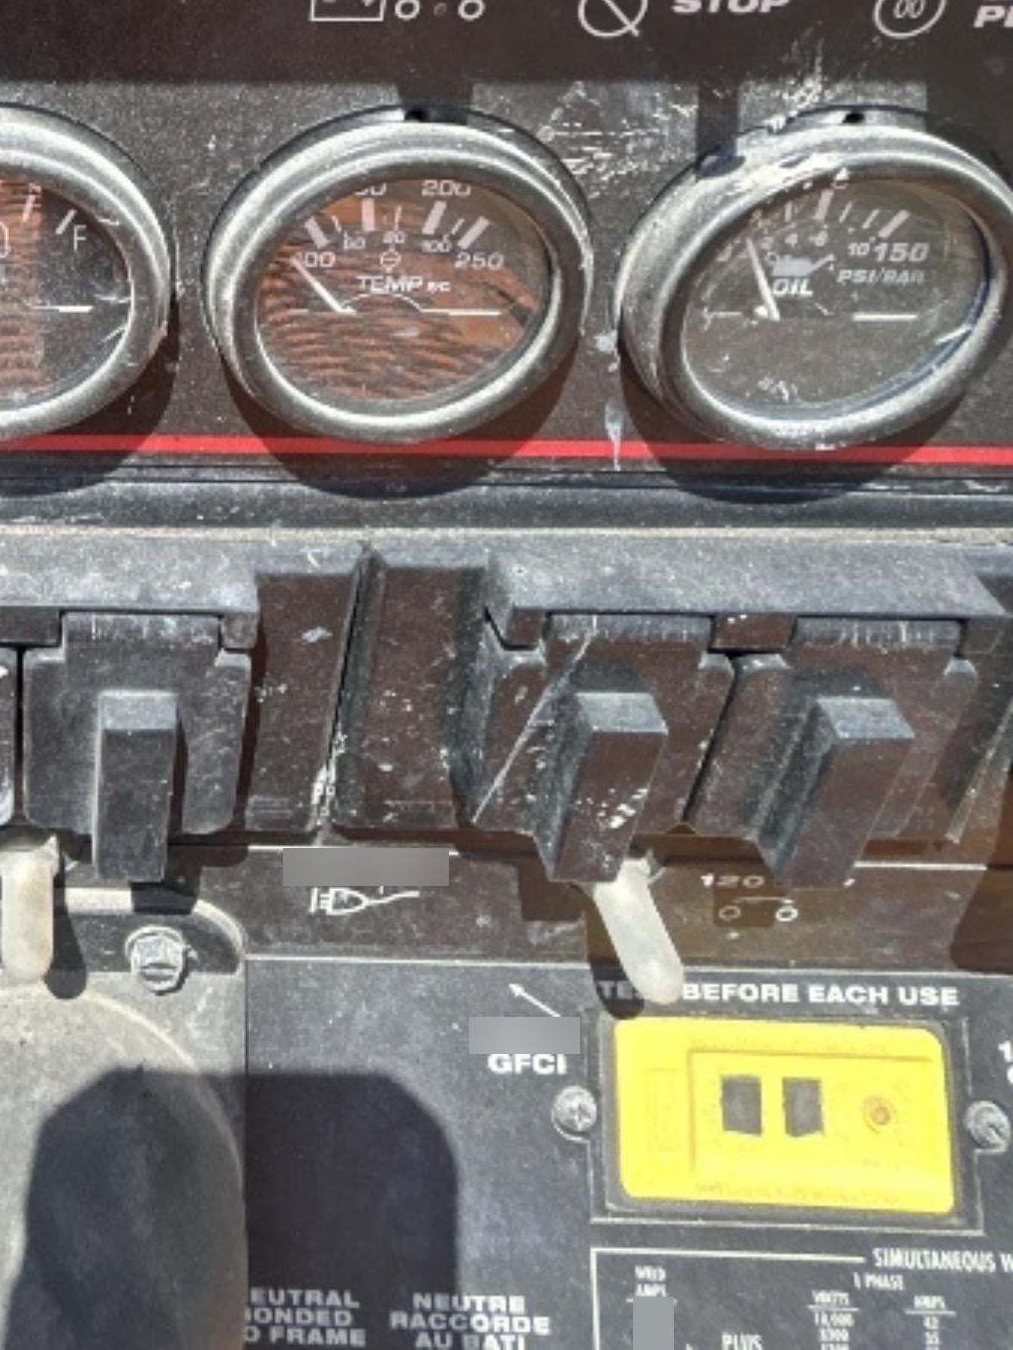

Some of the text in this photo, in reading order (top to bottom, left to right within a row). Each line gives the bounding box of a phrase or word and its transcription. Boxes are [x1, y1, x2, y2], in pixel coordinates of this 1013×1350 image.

[72, 225, 87, 251] F
[455, 252, 504, 270] 250
[873, 242, 929, 263] 150
[357, 275, 423, 293] TEMP
[771, 278, 814, 297] OIL
[682, 982, 799, 1003] BEFORE
[808, 984, 889, 1005] EACH
[898, 986, 961, 1007] USE
[487, 1052, 568, 1075] GFCI
[249, 1286, 361, 1309] EUTRAL
[411, 1292, 527, 1315] NEUTRE
[389, 1310, 552, 1336] RACCORDE
[270, 1328, 366, 1347] FRAME
[415, 1332, 453, 1349] AU
